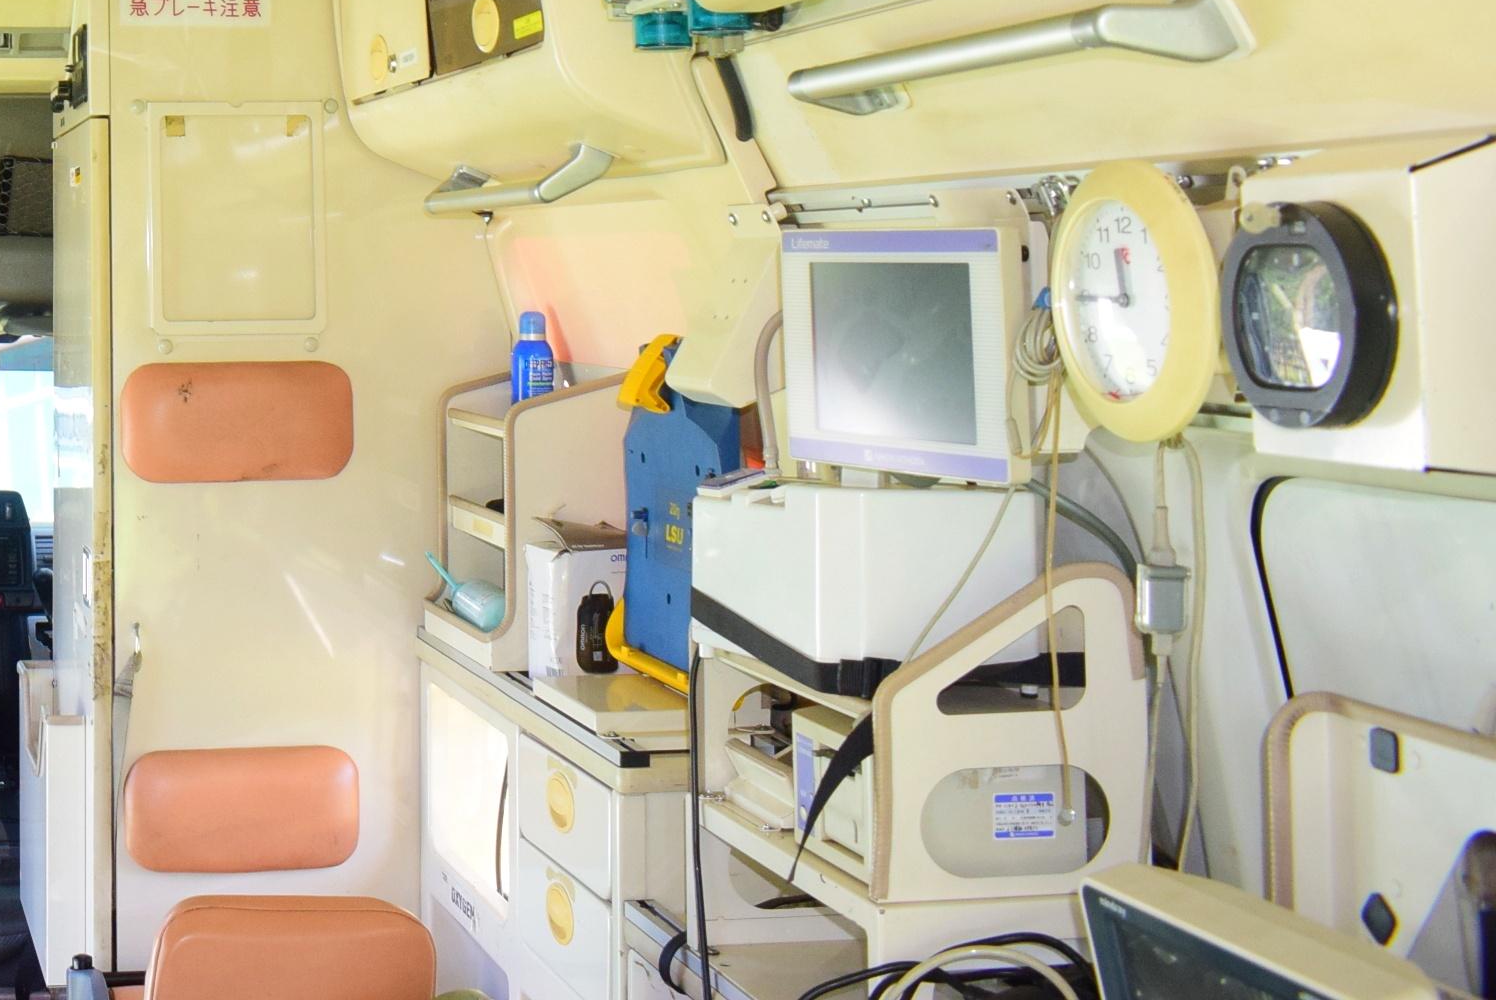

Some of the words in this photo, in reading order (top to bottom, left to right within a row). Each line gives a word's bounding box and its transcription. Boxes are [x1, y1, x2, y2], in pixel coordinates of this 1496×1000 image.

[1114, 216, 1132, 234] 12
[1097, 228, 1110, 243] 11
[1084, 252, 1101, 270] 10
[1146, 359, 1157, 377] 5
[666, 524, 684, 545] LSU
[610, 553, 627, 562] om
